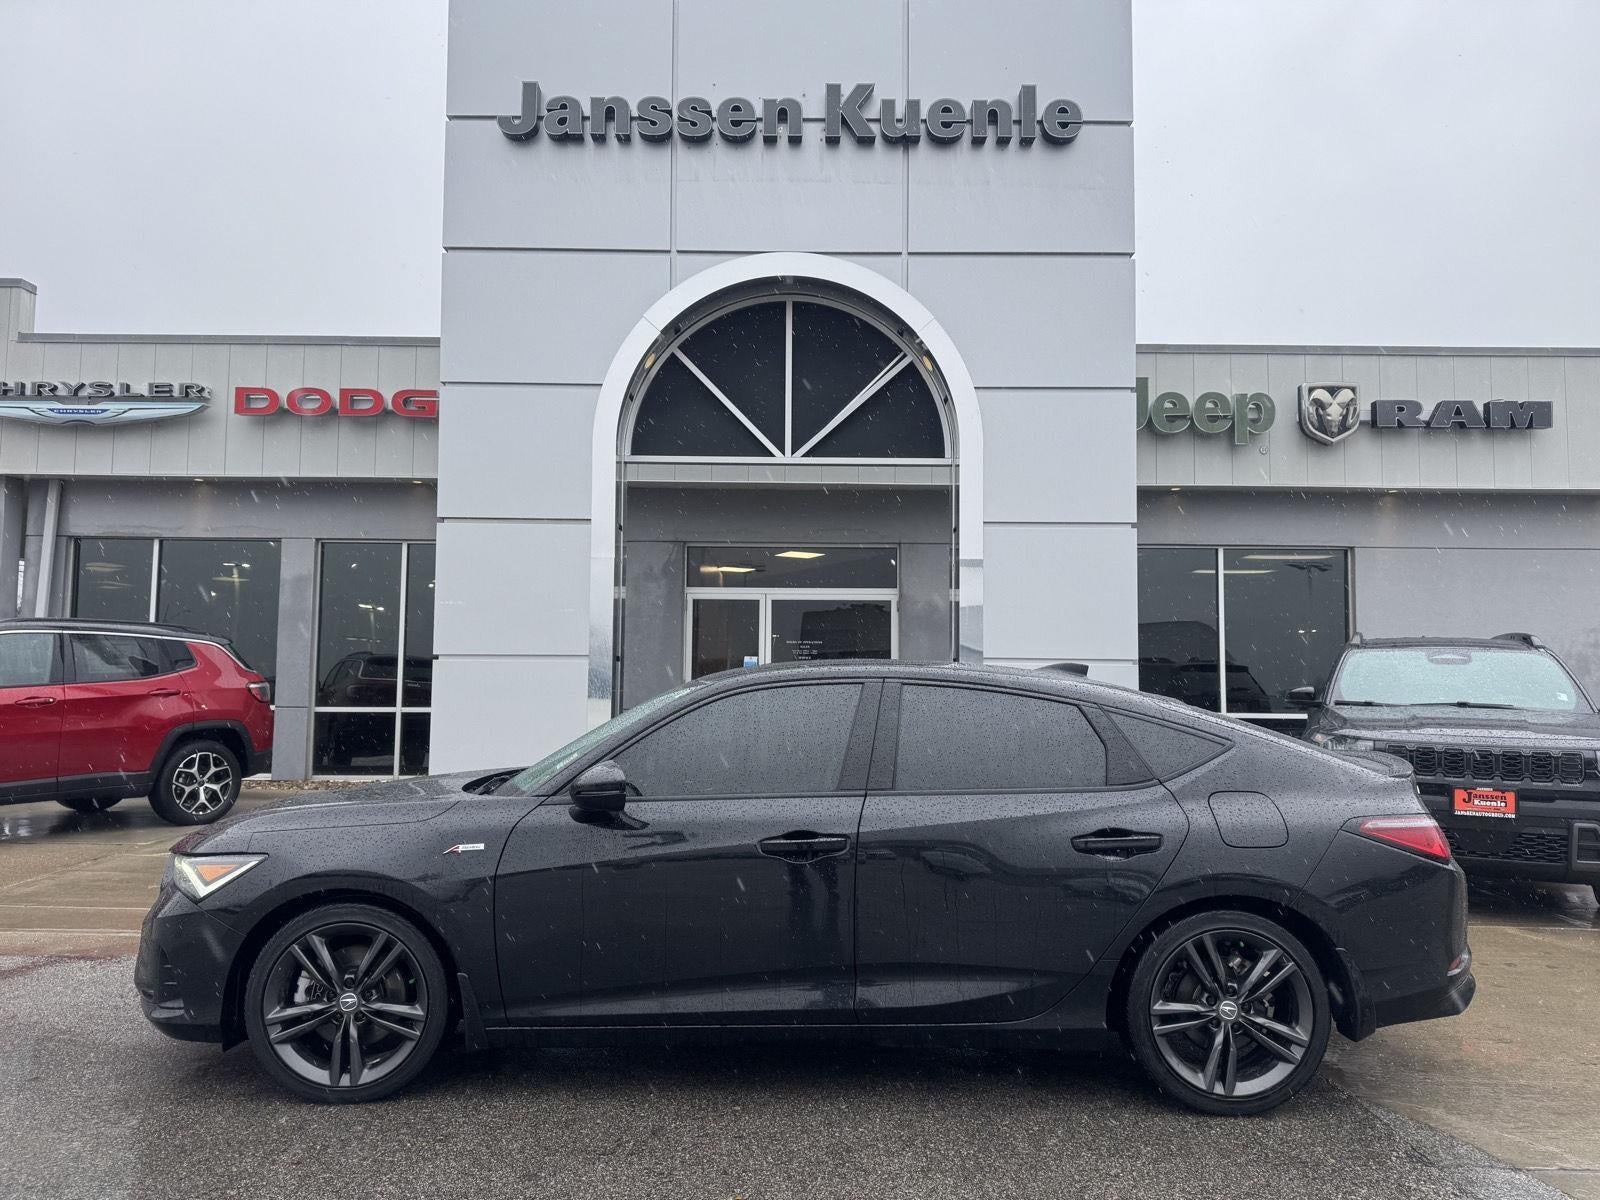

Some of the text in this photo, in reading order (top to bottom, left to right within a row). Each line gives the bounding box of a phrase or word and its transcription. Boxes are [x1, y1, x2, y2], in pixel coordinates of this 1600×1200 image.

[496, 80, 1083, 143] Janssen Kuenle
[234, 386, 438, 417] DODG
[1136, 377, 1276, 445] Jeep
[1371, 399, 1553, 429] RAM
[1463, 791, 1507, 803] Janssen
[1473, 799, 1506, 807] Kuenle
